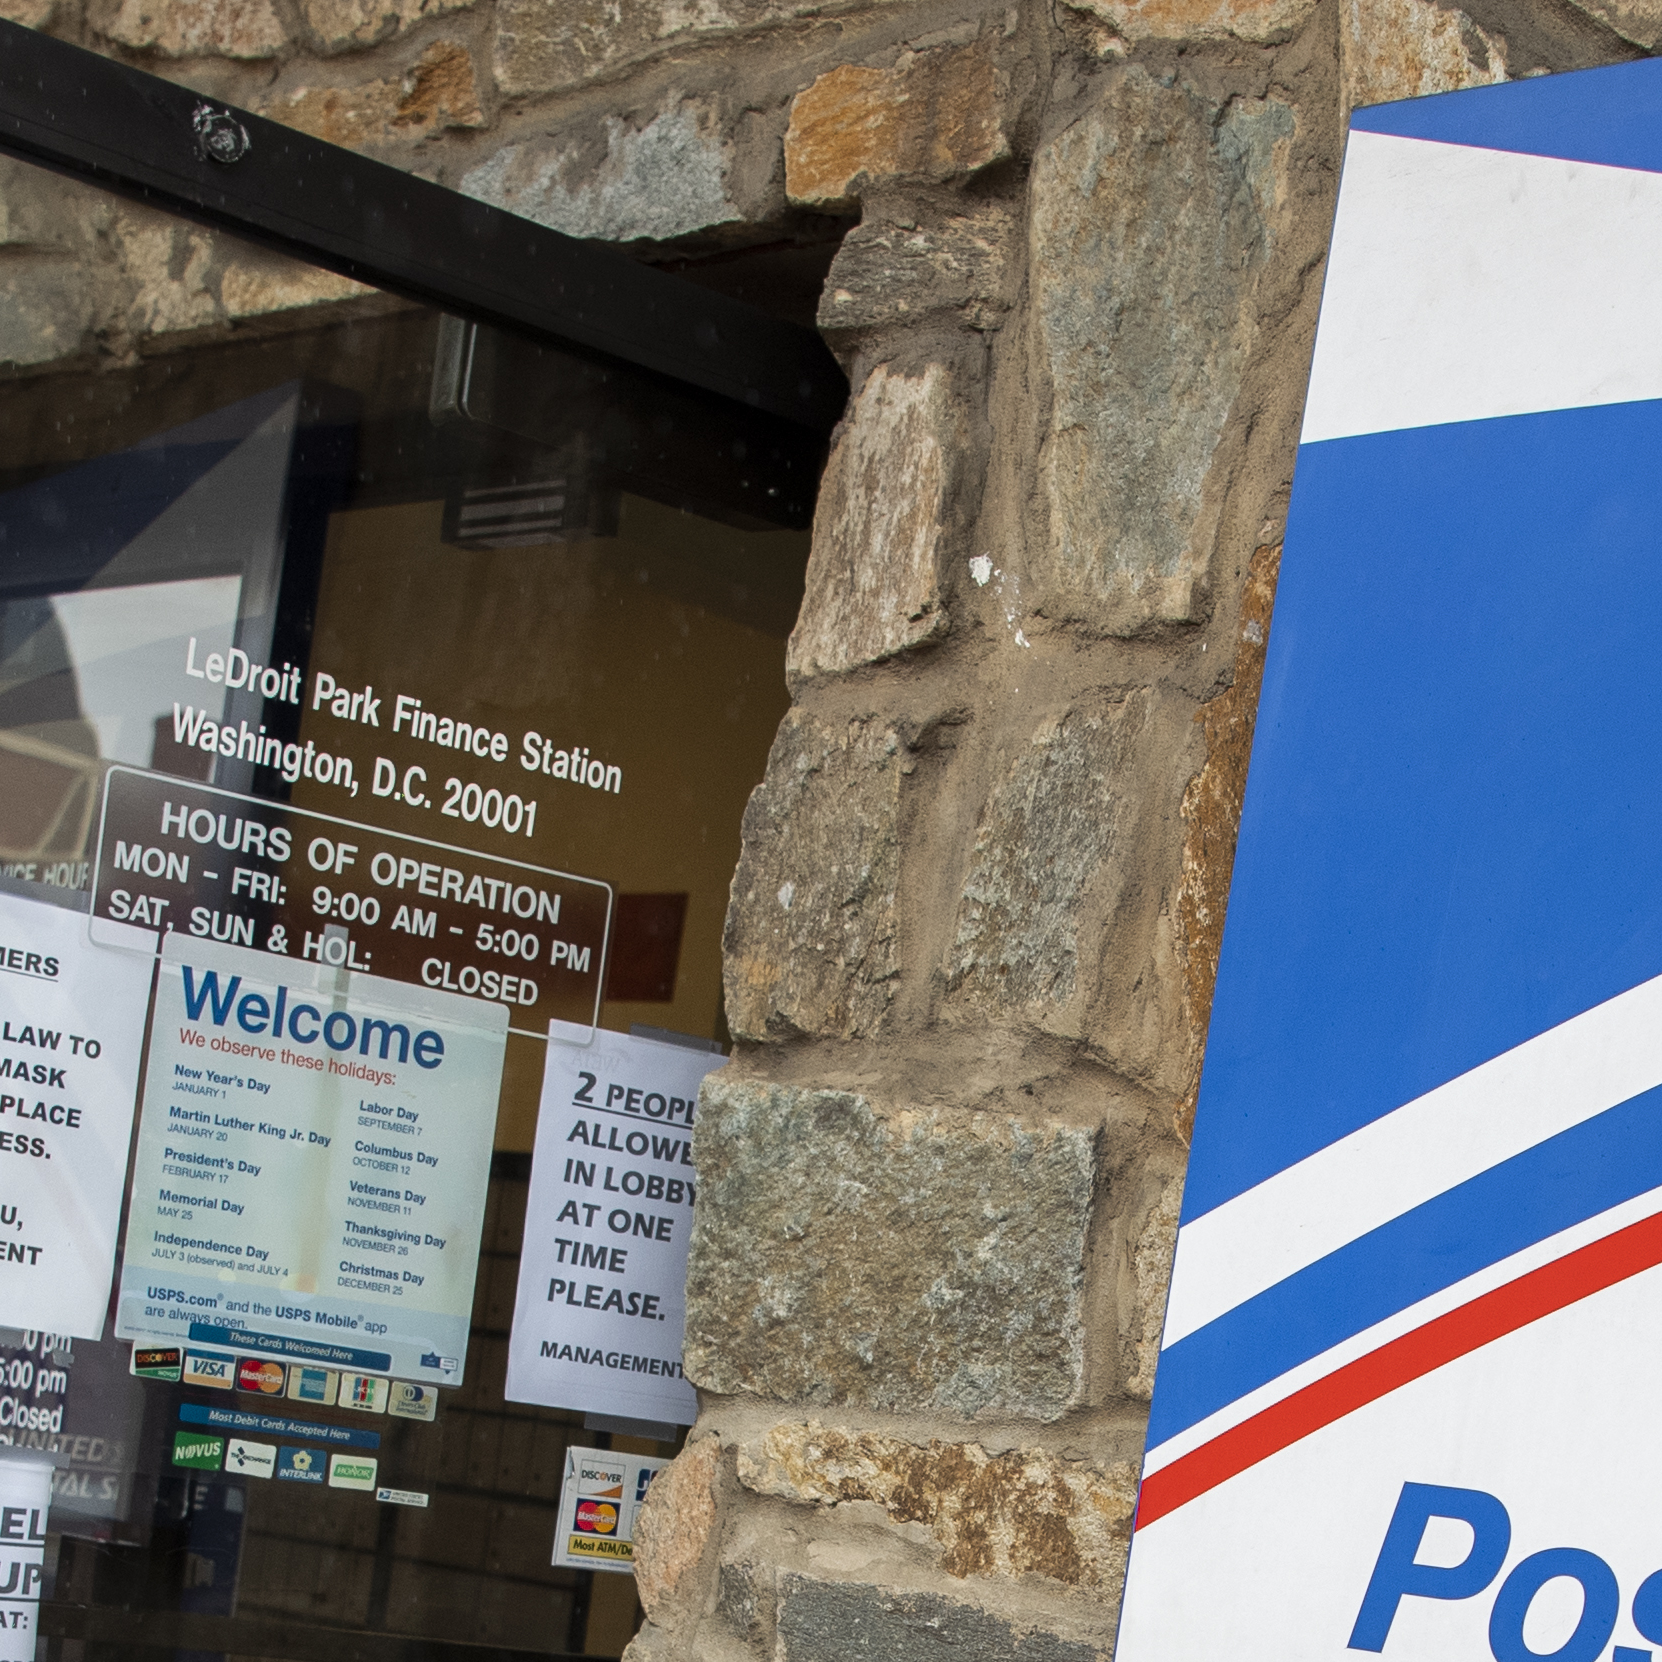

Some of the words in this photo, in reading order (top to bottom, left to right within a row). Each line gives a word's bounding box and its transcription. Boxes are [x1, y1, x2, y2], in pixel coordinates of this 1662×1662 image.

[186, 637, 302, 705] LeDroit
[312, 672, 382, 727] Park
[393, 694, 509, 762] Finance
[520, 731, 623, 794] Station
[172, 702, 360, 798] Washington,
[372, 756, 432, 808] D.C.
[441, 777, 537, 837] 20001
[160, 802, 292, 862] HOURS
[308, 837, 358, 875] OF
[371, 852, 561, 924] OPERATION
[114, 841, 189, 884] MON
[231, 866, 287, 905] FRI:
[312, 886, 381, 926] 9:00
[390, 905, 437, 939] AM
[475, 924, 539, 961] 5:00
[550, 941, 591, 973] PM
[107, 888, 174, 932] SAT,
[189, 906, 254, 946] SUN
[267, 925, 288, 953] &
[303, 930, 371, 970] HOL:
[421, 958, 539, 1006] CLOSED
[182, 964, 445, 1069] Welcome
[2, 1022, 61, 1051] LAW
[69, 1035, 101, 1059] TO
[179, 1028, 206, 1048] We
[210, 1034, 276, 1061] observe
[281, 1050, 324, 1071] these
[328, 1058, 396, 1086] holidays:
[172, 1081, 219, 1097] JANUARY
[222, 1091, 226, 1099] 1
[174, 1064, 202, 1079] New
[206, 1070, 244, 1087] Year's
[247, 1078, 271, 1094] Day
[574, 1071, 597, 1103] 2
[0, 1094, 82, 1128] PLACE
[360, 1100, 394, 1116] Labor
[397, 1107, 419, 1122] Day
[167, 1123, 214, 1139] JANUARY
[216, 1132, 228, 1141] 20
[169, 1106, 211, 1123] Martin
[214, 1114, 255, 1131] Luther
[258, 1122, 286, 1139] King
[290, 1130, 305, 1141] Jr.
[308, 1132, 332, 1147] Day
[358, 1116, 415, 1135] SEPTEMBER
[417, 1127, 422, 1136] 7
[164, 1148, 234, 1170] President's
[238, 1161, 261, 1177] Day
[353, 1157, 398, 1173] OCTOBER
[401, 1166, 410, 1175] 12
[355, 1140, 413, 1161] Columbus
[417, 1152, 438, 1167] Day
[162, 1164, 217, 1181] FEBRUARY
[219, 1175, 229, 1184] 17
[564, 1158, 596, 1187] IN
[159, 1189, 218, 1209] Memorial
[221, 1200, 245, 1215] Day
[347, 1196, 401, 1213] NOVEMBER
[403, 1207, 412, 1215] 11
[350, 1180, 401, 1199] Veterans
[404, 1190, 426, 1205] Day
[157, 1206, 180, 1218] MAY
[556, 1200, 601, 1228] AT
[608, 1209, 674, 1242] ONE
[154, 1231, 242, 1255] Independence
[246, 1246, 269, 1260] Day
[342, 1237, 396, 1254] NOVEMBER
[345, 1221, 421, 1245] Thanksgiving
[424, 1234, 446, 1249] Day
[152, 1249, 177, 1260] JULY
[187, 1253, 235, 1270] (observed)
[238, 1261, 255, 1272] and
[257, 1265, 280, 1276] JULY
[282, 1268, 288, 1276] 4
[555, 1238, 628, 1274] TIME
[338, 1277, 390, 1293] DECEMBER
[339, 1261, 399, 1281] Christmas
[403, 1271, 424, 1286] Day
[547, 1278, 665, 1321] PLEASE.
[145, 1306, 165, 1318] are
[168, 1308, 211, 1327] always
[226, 1299, 250, 1313] and
[253, 1302, 272, 1317] the
[275, 1306, 311, 1322] USPS
[364, 1322, 387, 1334] app
[229, 1332, 256, 1345] These
[258, 1336, 284, 1349] Cards
[286, 1340, 332, 1358] Welcomed
[336, 1348, 354, 1361] Here
[35, 1367, 67, 1398] pm
[192, 1359, 226, 1378] VISA
[208, 1410, 233, 1422] Most
[234, 1414, 259, 1427] Debit
[261, 1419, 285, 1431] Cards
[288, 1422, 328, 1438] Accepted
[330, 1429, 350, 1440] Here
[581, 1470, 622, 1483] DISCOVER
[573, 1539, 594, 1551] Most
